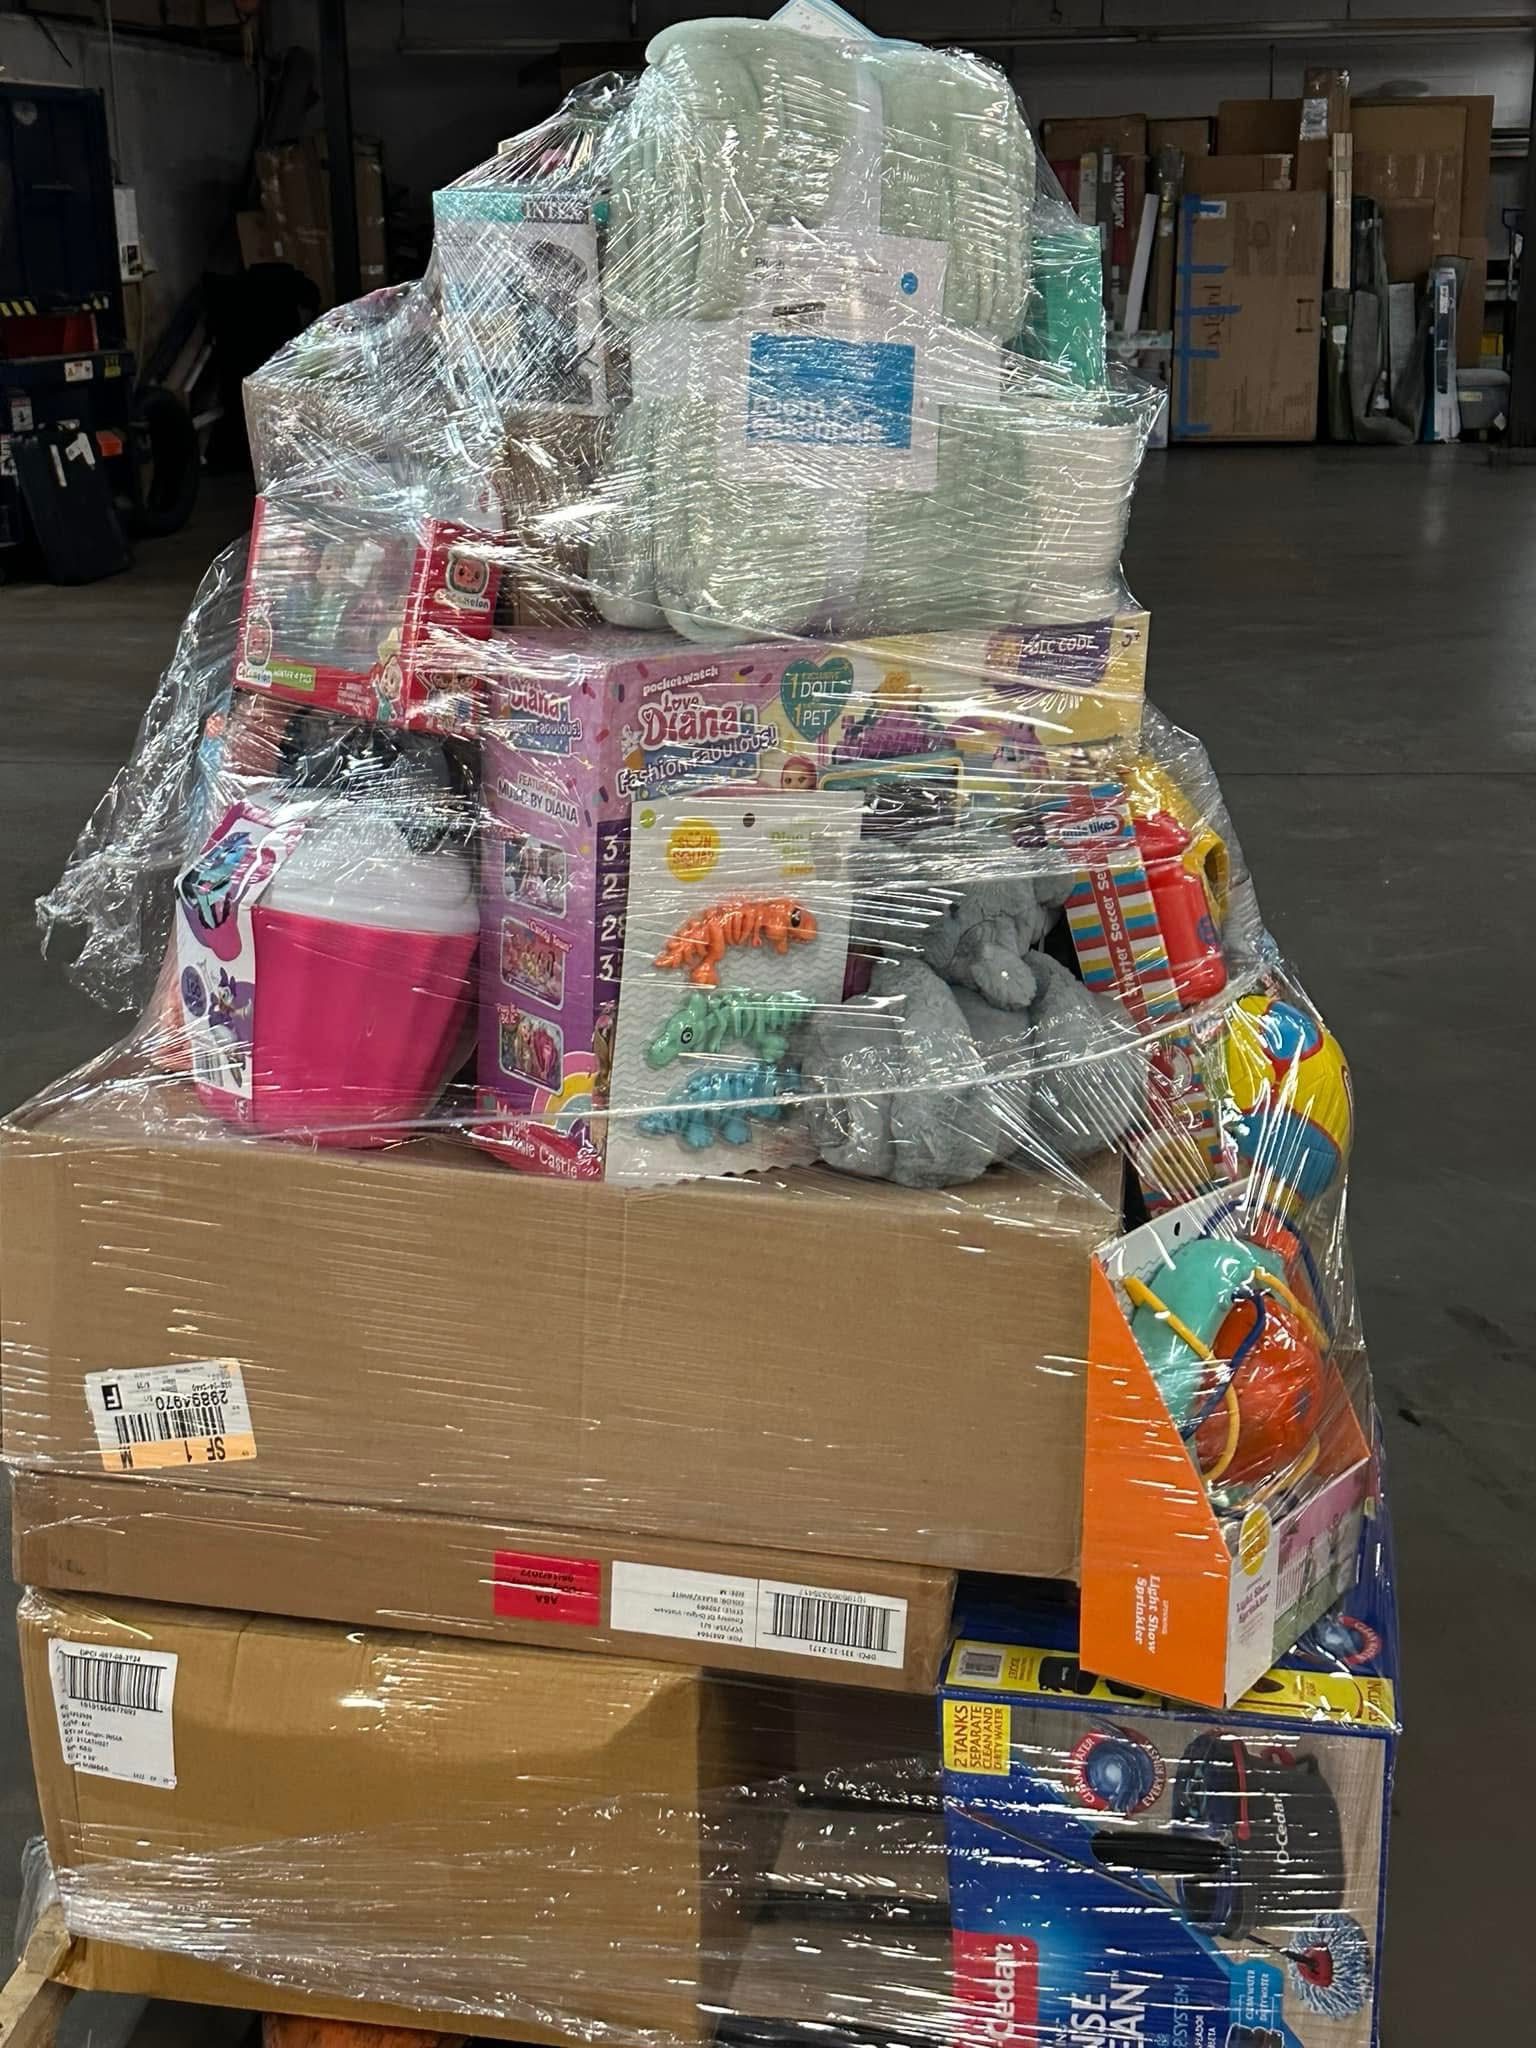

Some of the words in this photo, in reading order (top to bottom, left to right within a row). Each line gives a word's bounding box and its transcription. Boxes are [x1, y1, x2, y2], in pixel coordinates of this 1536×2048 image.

[641, 701, 739, 747] Diana
[802, 709, 832, 727] PET
[530, 794, 545, 810] BY
[544, 798, 579, 825] DIANA
[1103, 895, 1123, 942] Soccer
[539, 1144, 579, 1179] Castle
[207, 1436, 226, 1461] SF
[1134, 1576, 1148, 1646] Sprinkler
[1147, 1573, 1161, 1613] Light
[1147, 1613, 1159, 1655] Show
[954, 1704, 969, 1754] TANKS
[970, 1705, 983, 1769] SEPARATE
[983, 1706, 993, 1733] AND
[954, 1755, 969, 1769] 2
[983, 1734, 993, 1770] CLEAN
[1142, 1776, 1165, 1807] EVERY
